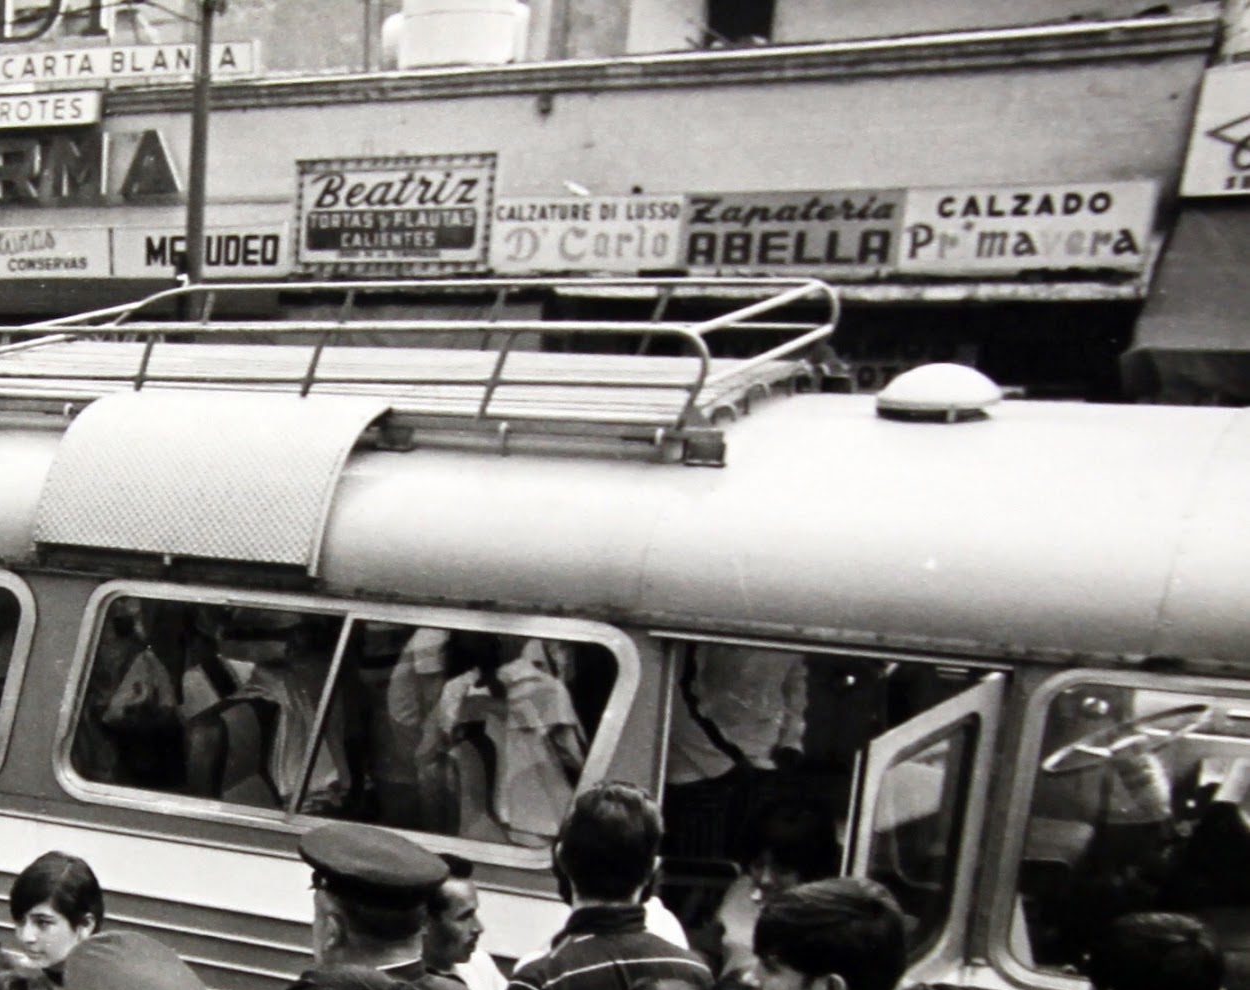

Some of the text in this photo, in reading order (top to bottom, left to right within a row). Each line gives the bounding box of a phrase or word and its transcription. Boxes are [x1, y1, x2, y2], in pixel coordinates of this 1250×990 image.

[2, 53, 94, 79] CARTA
[112, 46, 236, 73] BLANA
[312, 171, 479, 208] Beatriz
[937, 191, 1113, 218] CALZADO
[310, 213, 374, 229] TORTAS
[393, 210, 474, 228] FLAUTAS
[496, 202, 681, 221] CALZATURE DI LUSSO
[145, 234, 280, 267] MEUDEO
[340, 231, 436, 247] CALIENTES
[687, 229, 892, 265] ABELLA
[906, 221, 1141, 259] Prmavera
[7, 257, 87, 272] CONSERVAS
